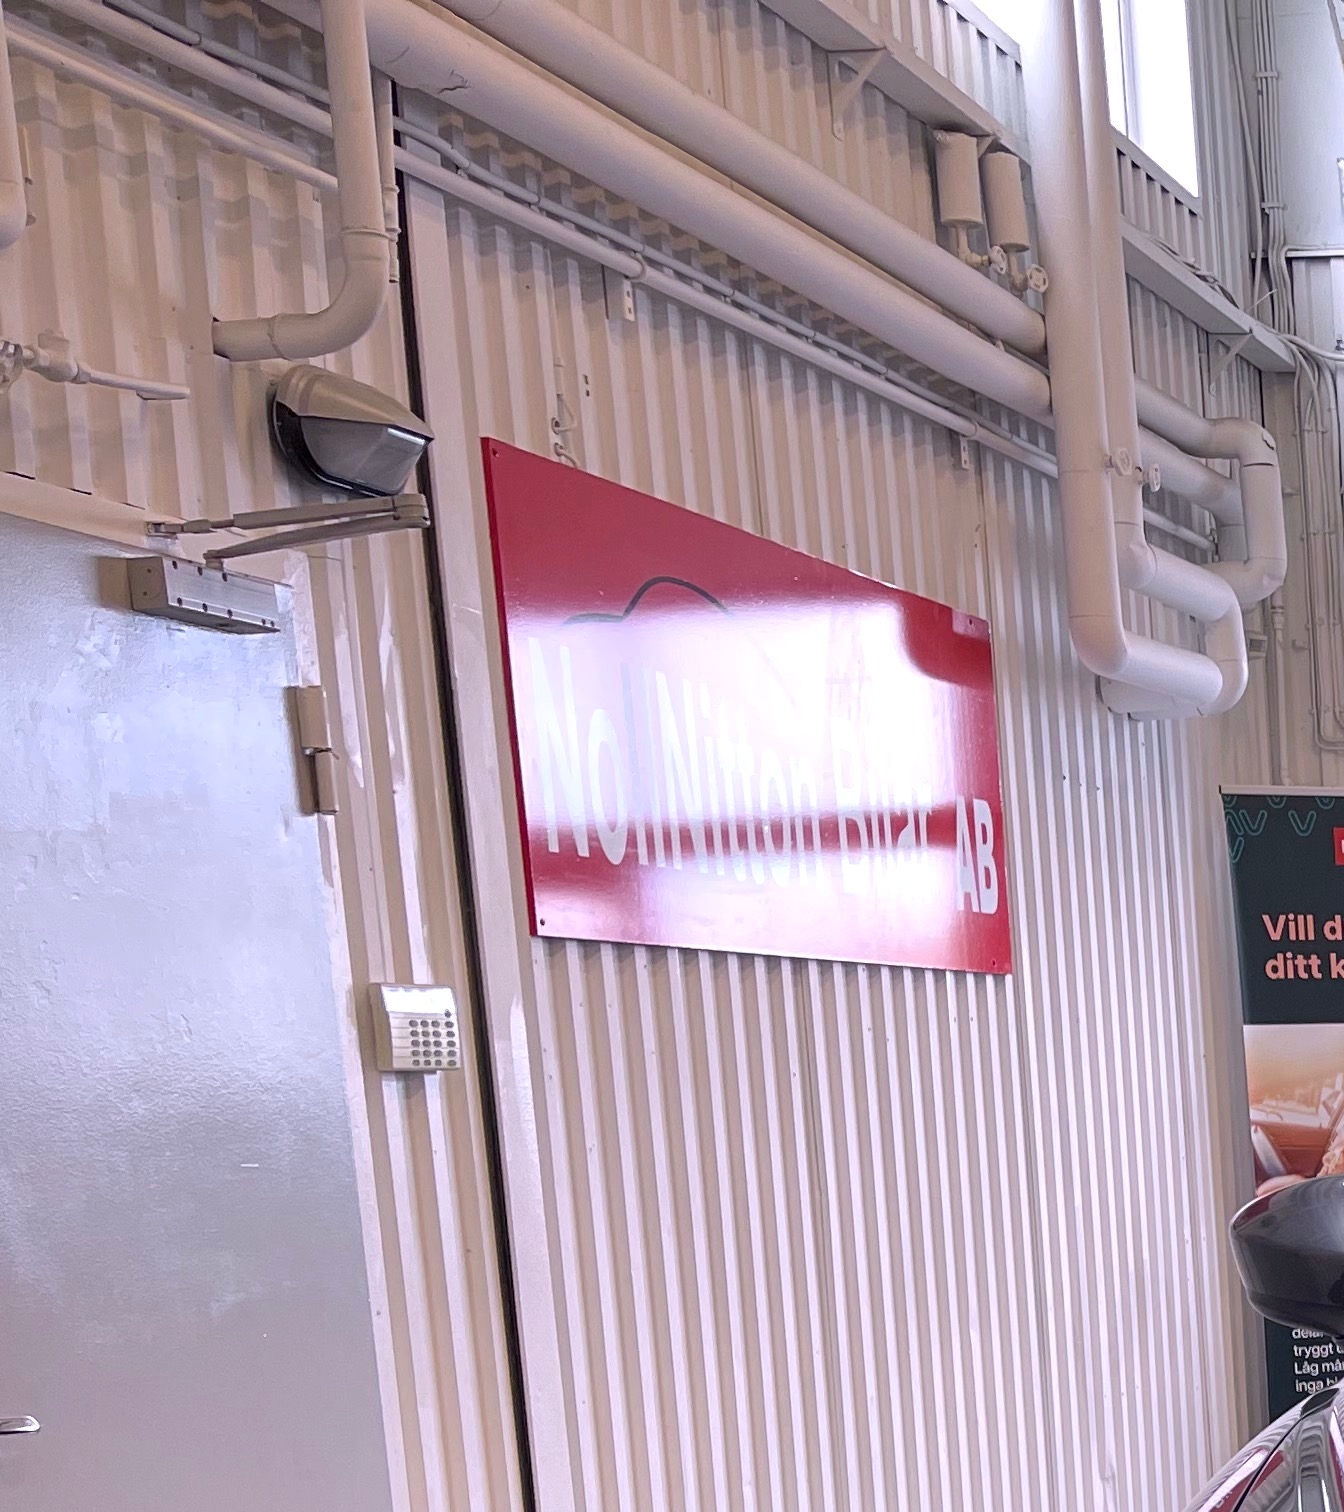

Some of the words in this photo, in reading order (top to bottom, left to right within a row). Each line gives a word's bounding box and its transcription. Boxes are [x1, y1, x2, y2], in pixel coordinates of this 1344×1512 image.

[956, 795, 999, 915] AB
[1261, 913, 1315, 941] Vill
[1265, 951, 1323, 980] ditt
[1294, 1343, 1333, 1358] tryggt
[1294, 1361, 1319, 1376] Låg
